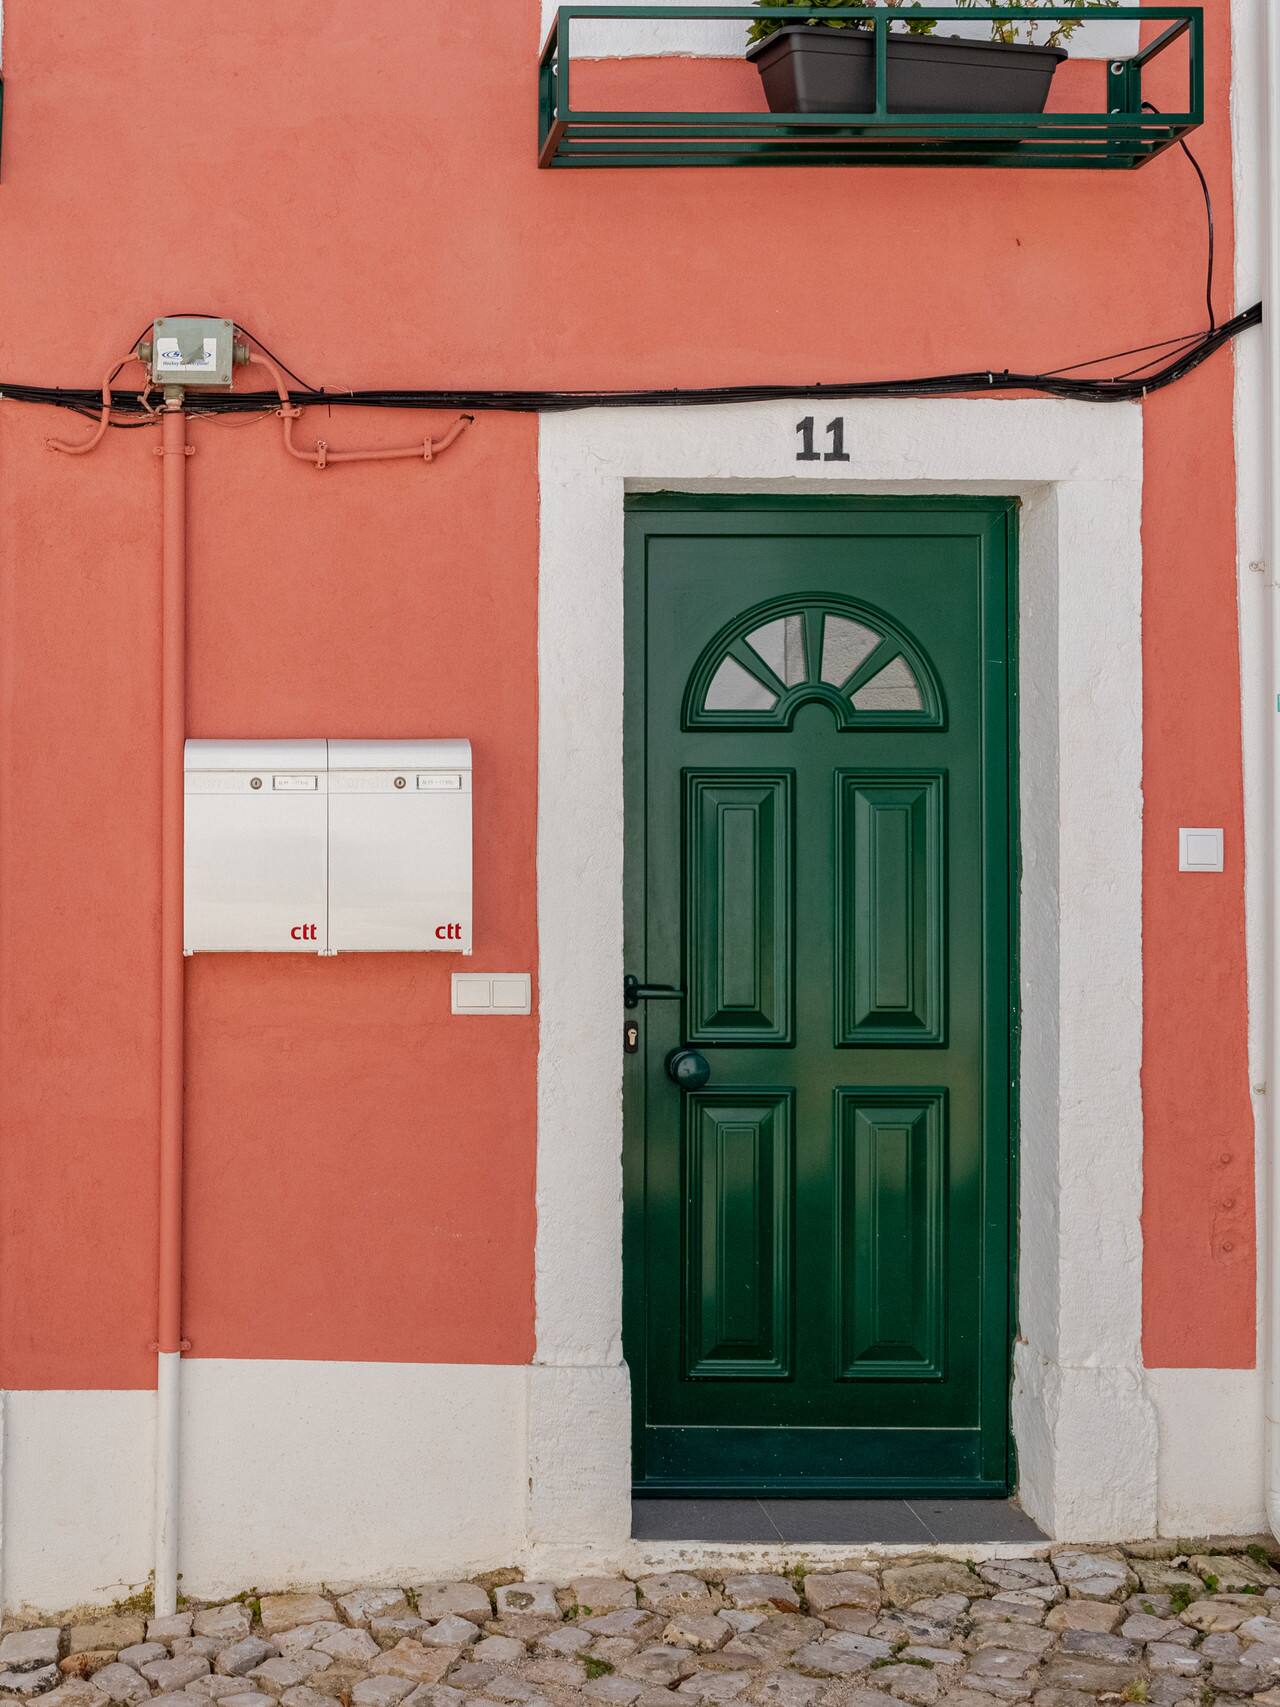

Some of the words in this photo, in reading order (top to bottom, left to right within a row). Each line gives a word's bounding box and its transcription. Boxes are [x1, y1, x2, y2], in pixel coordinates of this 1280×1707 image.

[796, 416, 850, 462] 11
[290, 923, 317, 940] ctt
[435, 923, 462, 940] ctt
